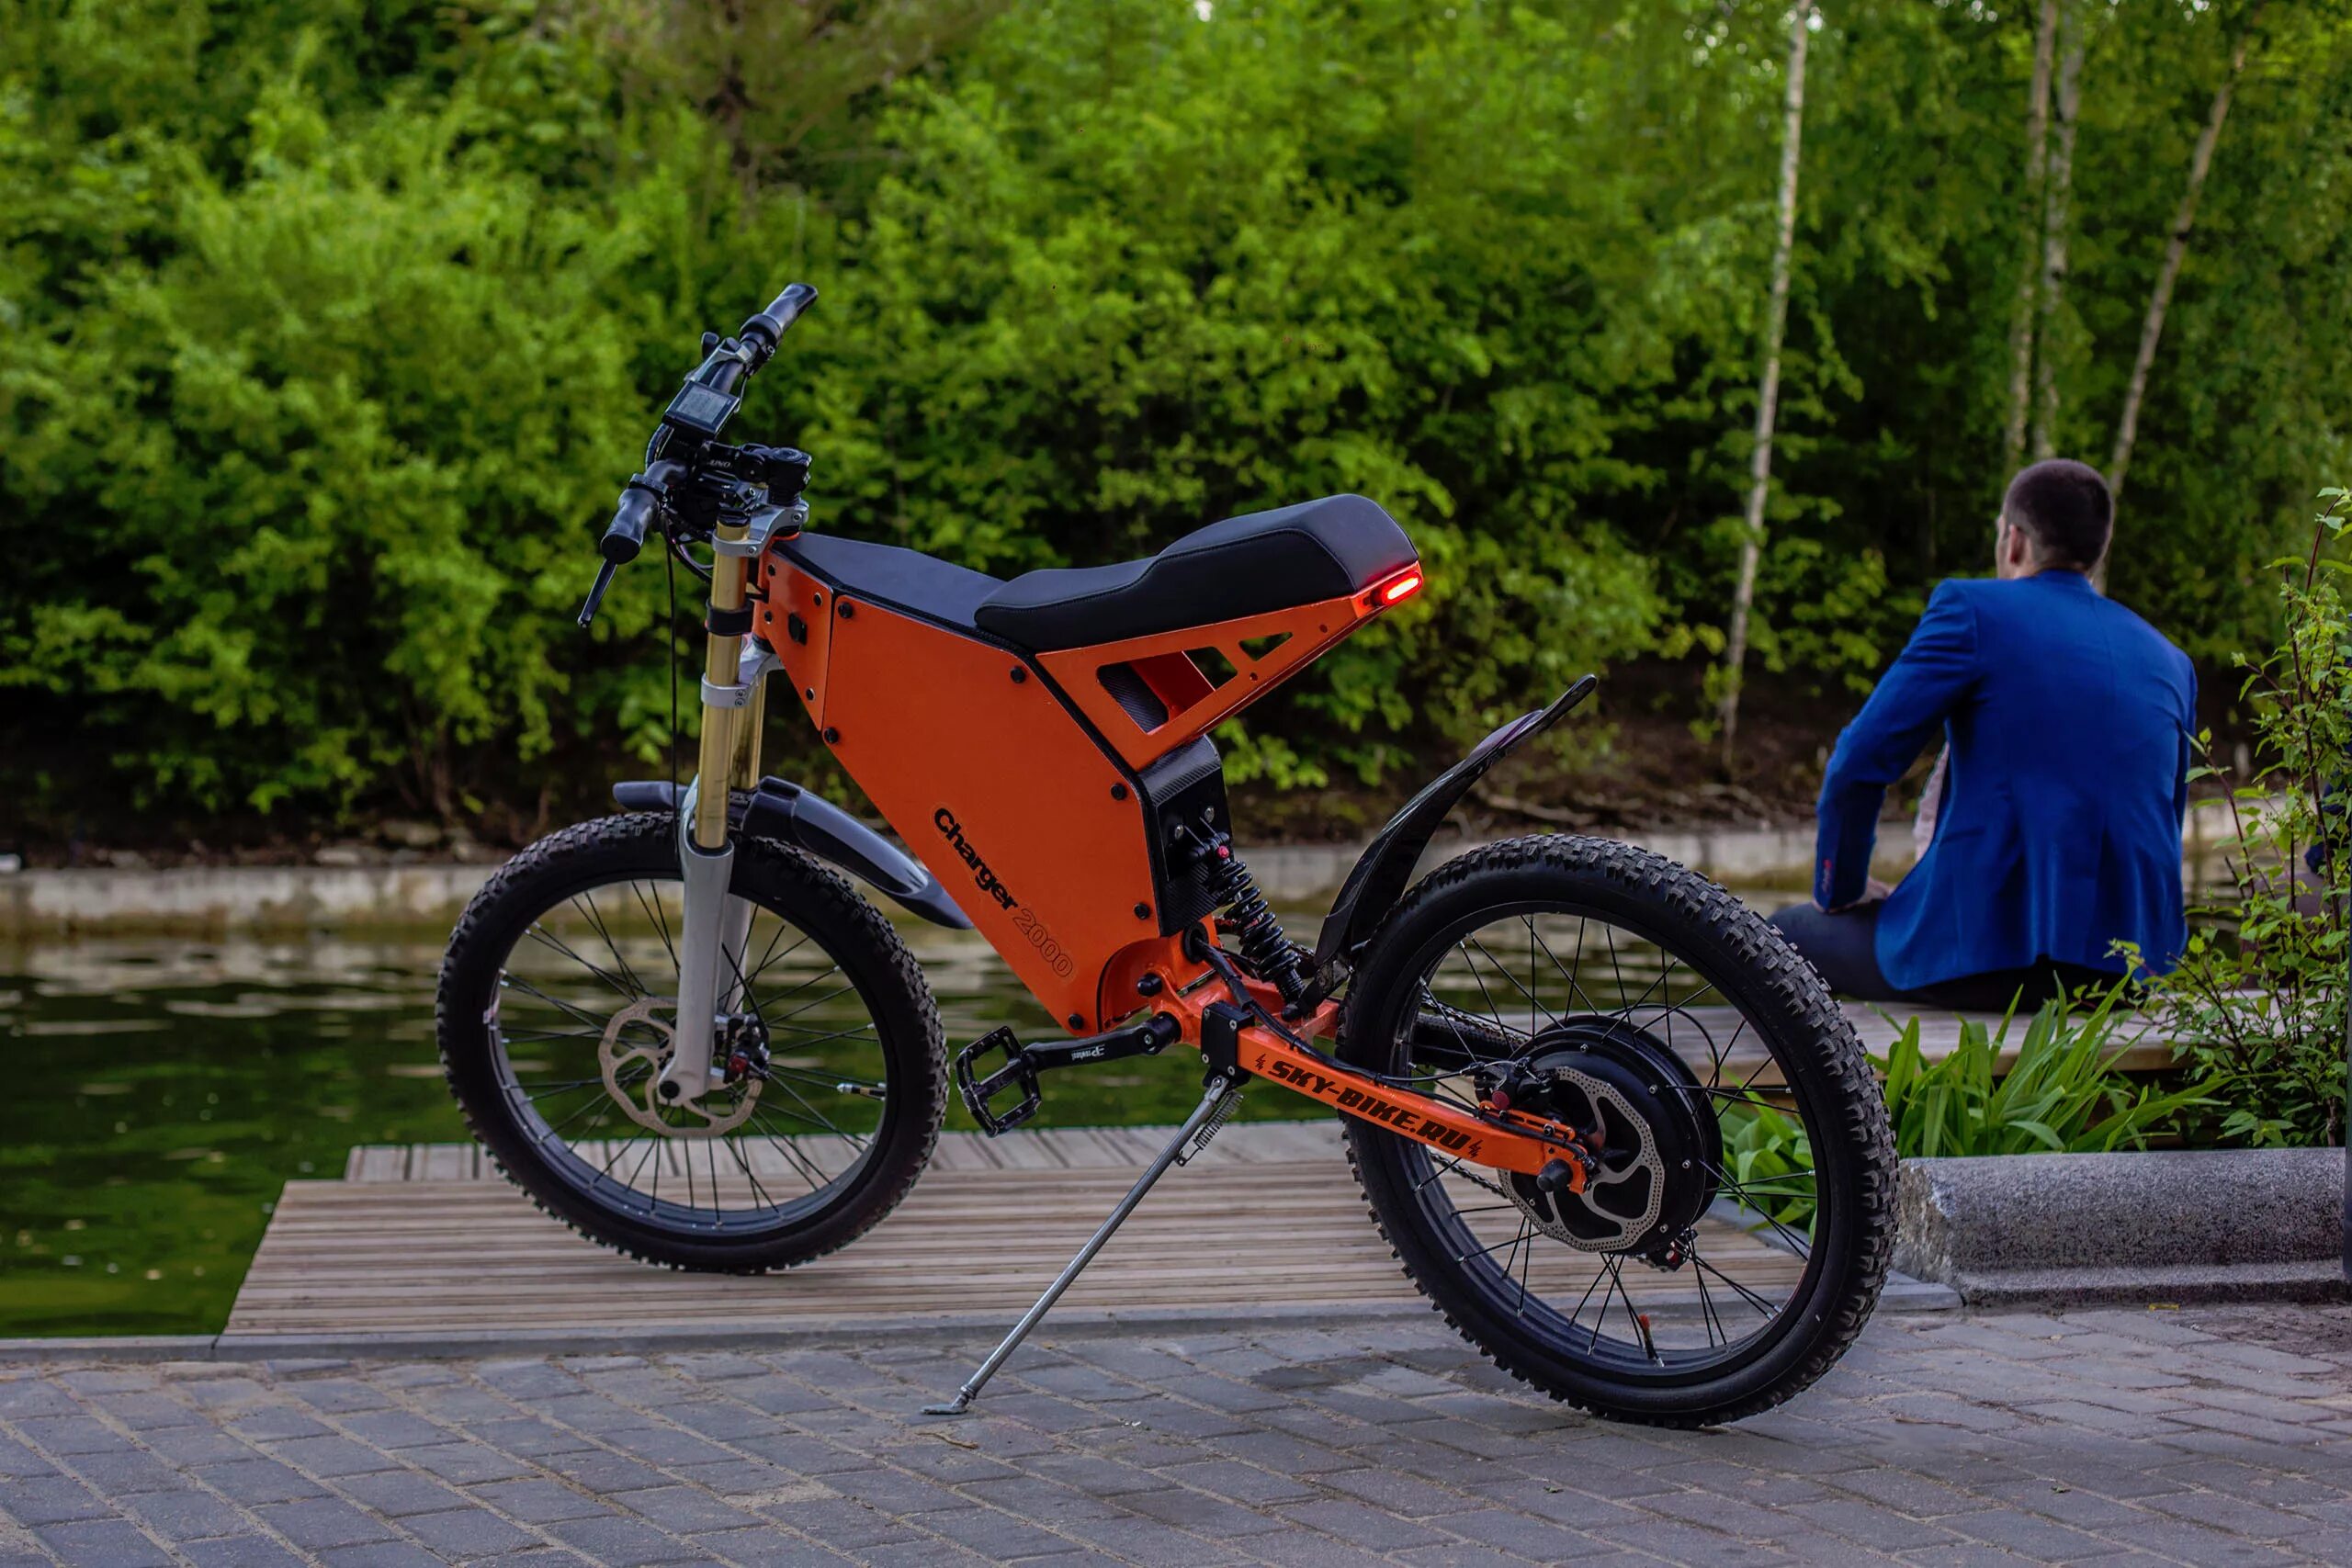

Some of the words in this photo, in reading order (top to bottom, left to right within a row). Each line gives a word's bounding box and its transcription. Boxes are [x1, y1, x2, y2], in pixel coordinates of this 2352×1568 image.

[933, 807, 1019, 910] Charger
[1013, 908, 1073, 978] 2000
[1268, 1060, 1472, 1150] SKY-BIKE.RU
